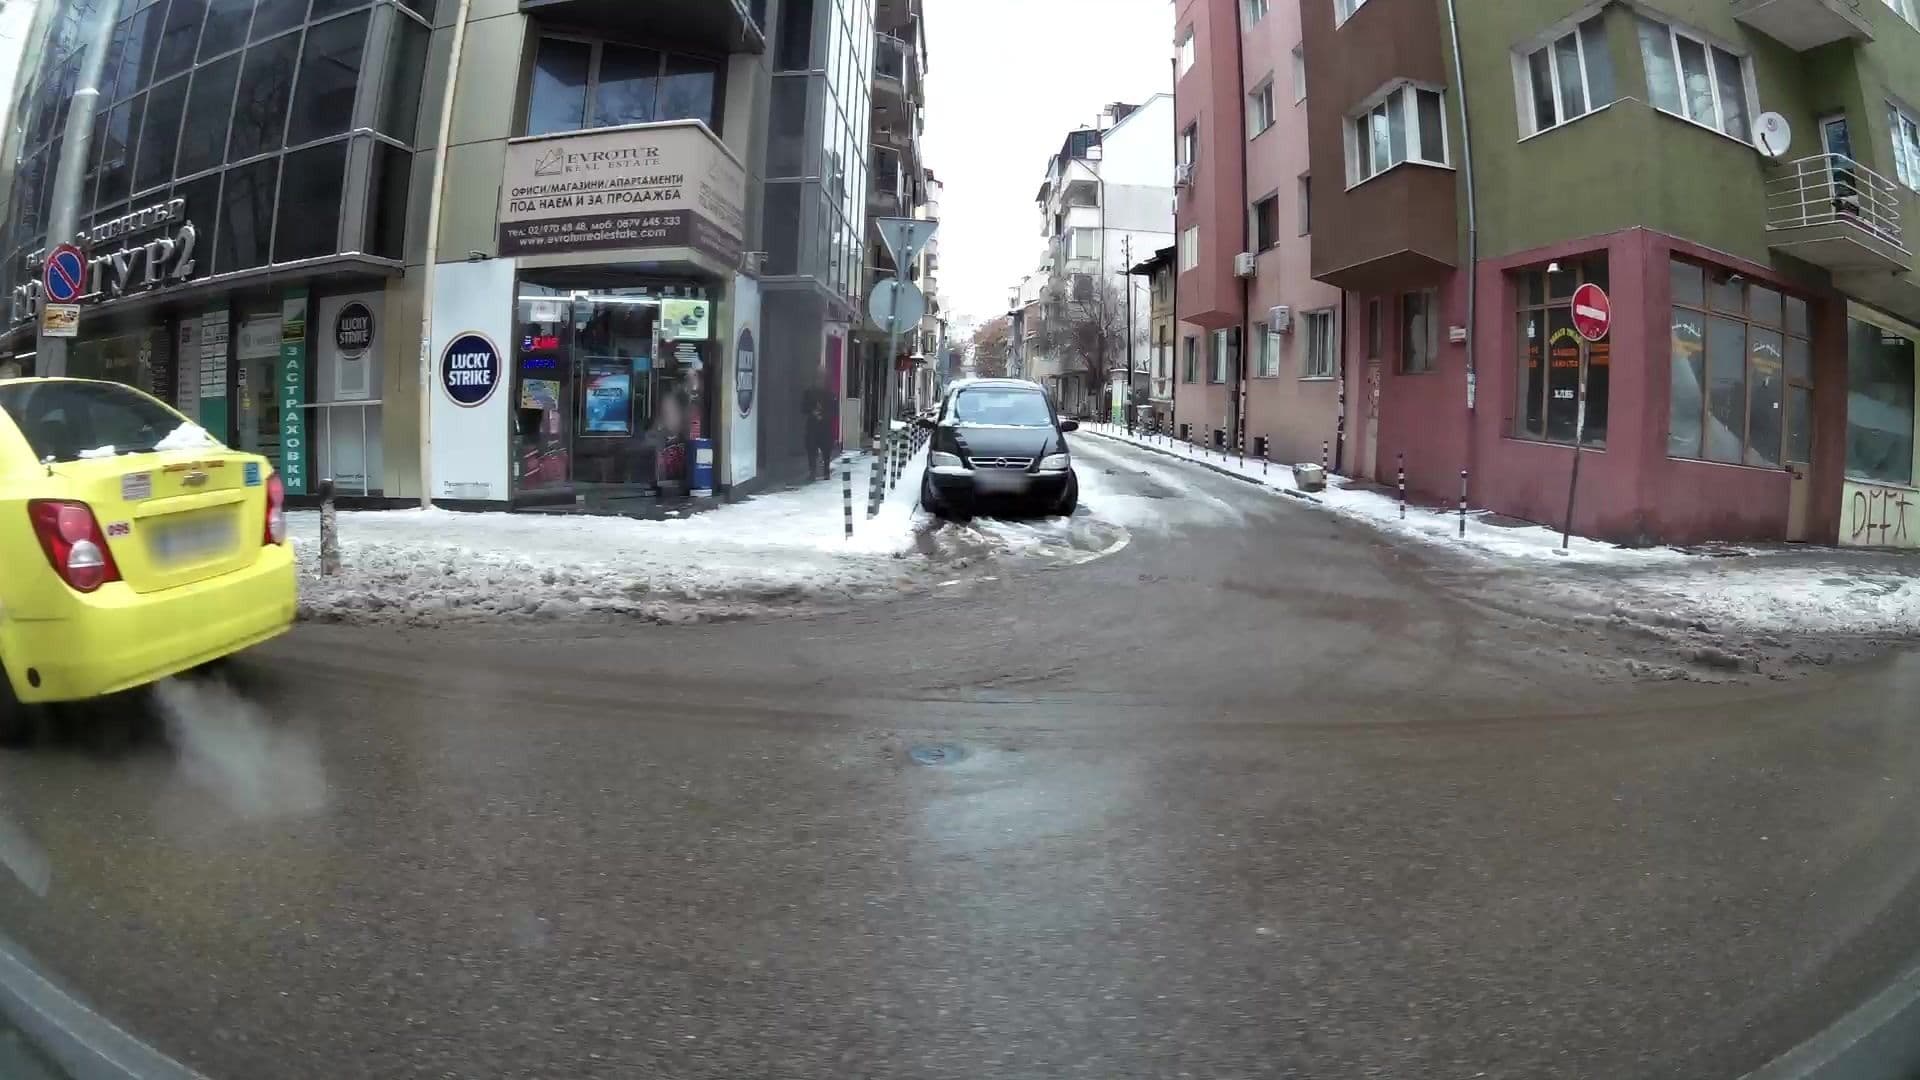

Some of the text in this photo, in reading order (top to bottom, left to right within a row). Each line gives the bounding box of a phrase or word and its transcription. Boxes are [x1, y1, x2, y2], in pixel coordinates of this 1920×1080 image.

[567, 147, 660, 164] EVROTUR
[607, 158, 661, 169] ESTATE
[510, 189, 681, 213] ПОД НАЕМ И ЗА ПРОДАЖБА
[451, 352, 491, 369] LUCKY
[448, 369, 491, 386] STRIKE
[285, 346, 301, 487] ЗАСТРАХОВКИ
